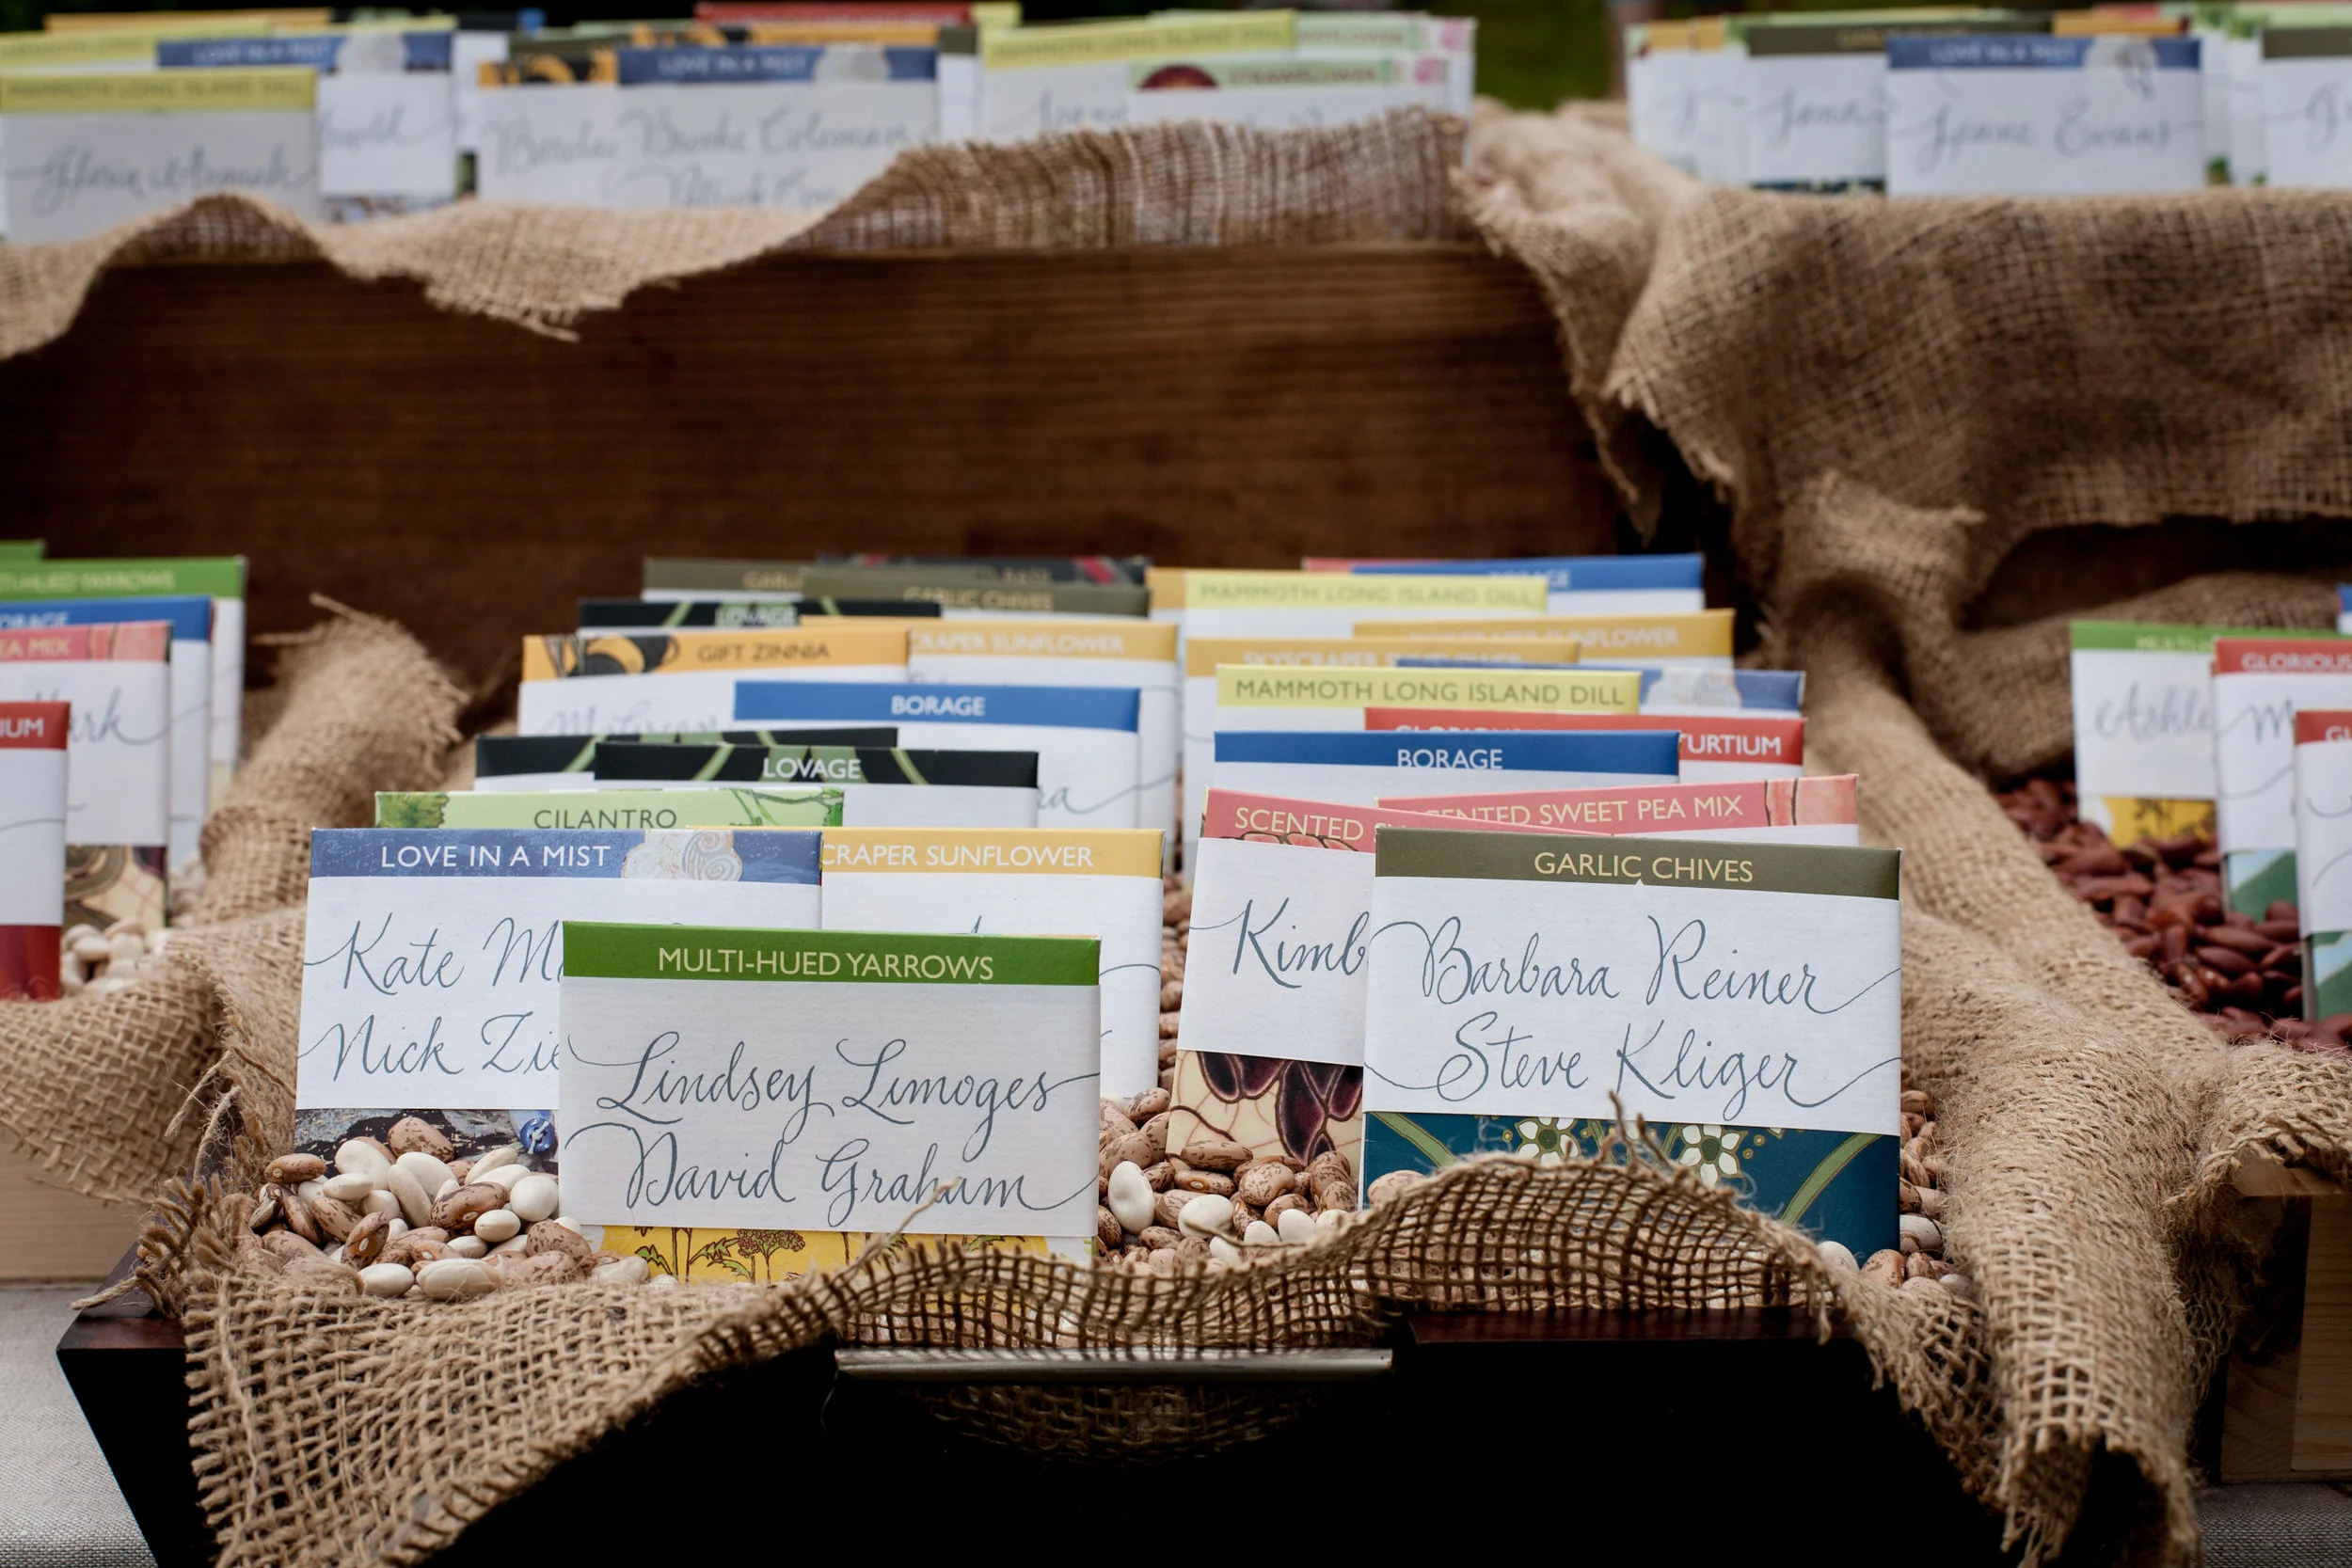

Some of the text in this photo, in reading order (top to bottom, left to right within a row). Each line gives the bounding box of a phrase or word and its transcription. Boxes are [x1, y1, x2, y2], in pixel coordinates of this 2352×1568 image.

[28, 637, 72, 657] MIX
[697, 638, 831, 663] GIFT ZINNIA
[890, 694, 987, 718] BORAGE
[1235, 678, 1626, 707] MAMMOTH LONG ISLAND DILL
[762, 756, 863, 780] LOVAGE
[1397, 748, 1504, 770] BORAGE
[533, 808, 678, 830] CILANTRO
[1234, 806, 1365, 842] SCENTED
[1538, 800, 1629, 826] SWEET
[1636, 797, 1687, 822] PEA
[1692, 794, 1746, 818] MIX
[380, 845, 612, 868] LOVE IN A MIST
[926, 845, 1094, 869] SUNFLOWER
[1534, 851, 1755, 884] GARLIC CHIVES
[303, 911, 464, 996] Kate
[657, 946, 994, 981] MULTI-HUED YARROWS
[1369, 913, 1901, 1015] Barbara Reiner
[297, 1014, 465, 1082] Nick
[1362, 1010, 1901, 1121] Steve Kliger
[566, 1031, 1102, 1163] Lindsey Limoges
[564, 1122, 1101, 1228] David Graham
